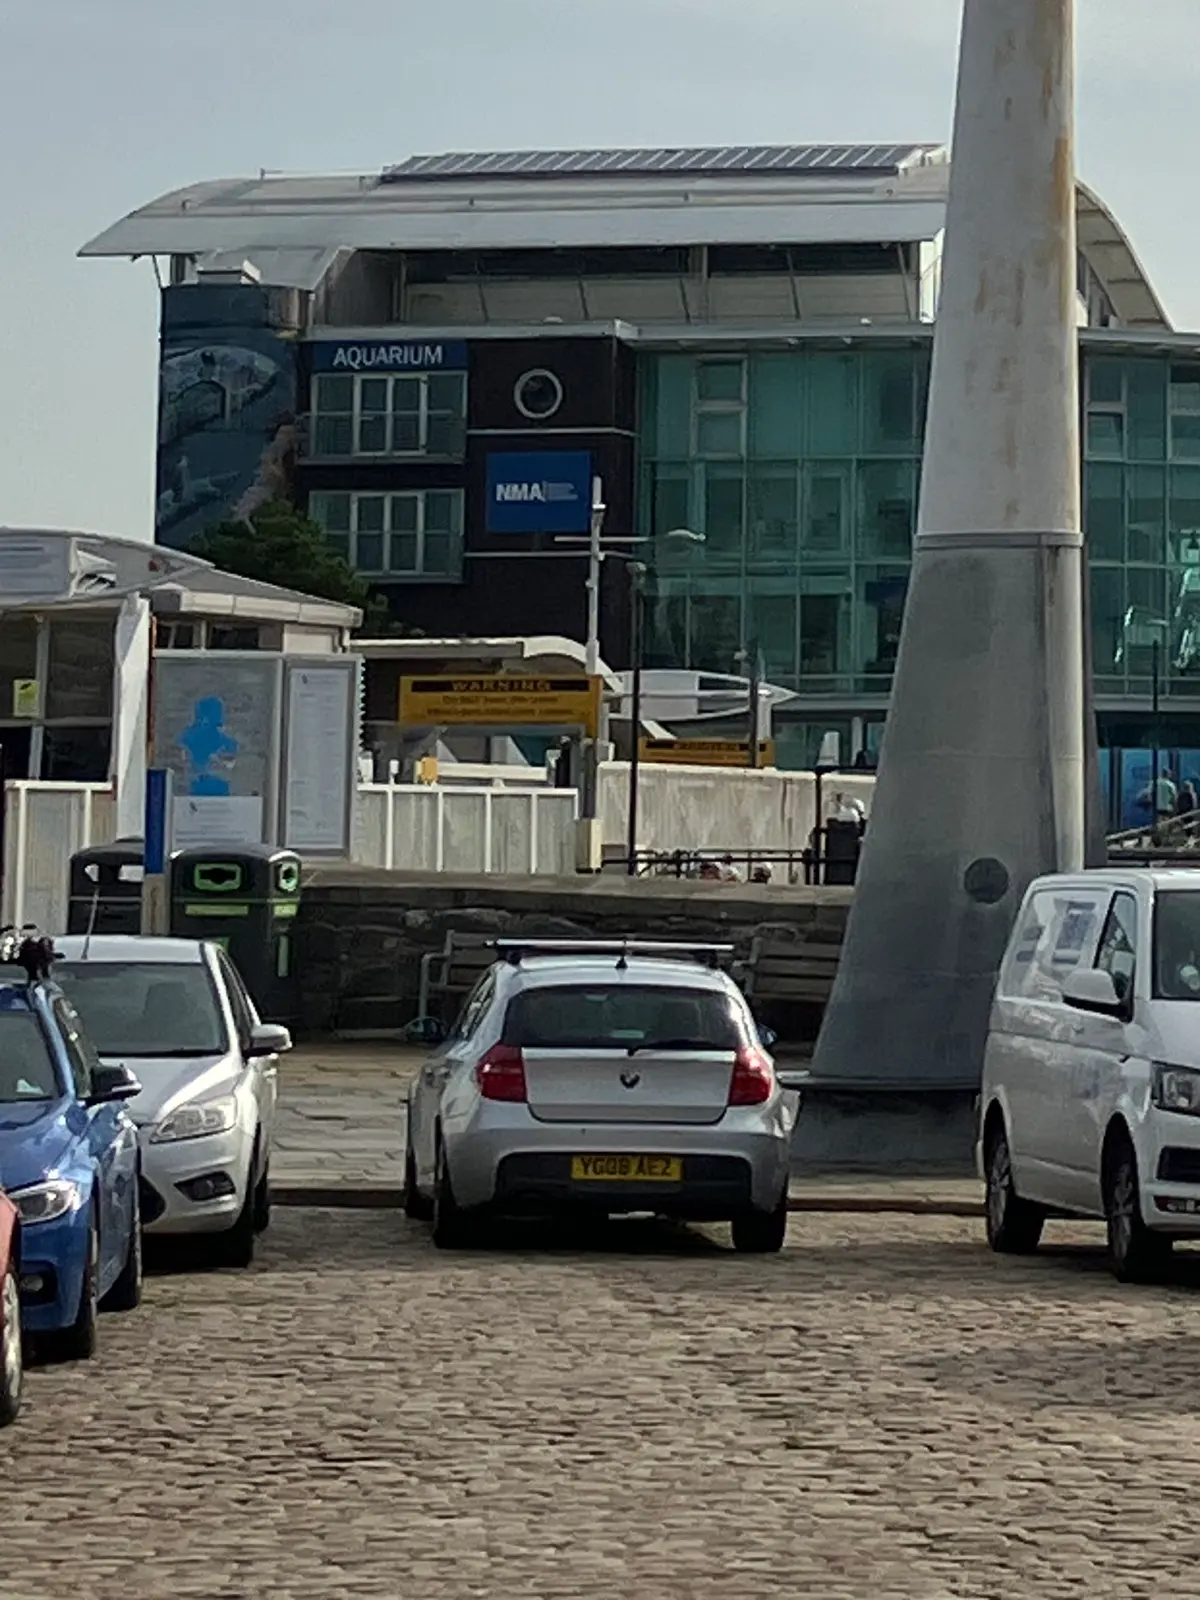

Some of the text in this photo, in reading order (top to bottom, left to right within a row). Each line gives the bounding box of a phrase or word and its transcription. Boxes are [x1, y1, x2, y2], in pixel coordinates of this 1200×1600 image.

[332, 345, 443, 369] AQUARIUM
[496, 483, 545, 501] NMA
[452, 680, 551, 692] WARNING
